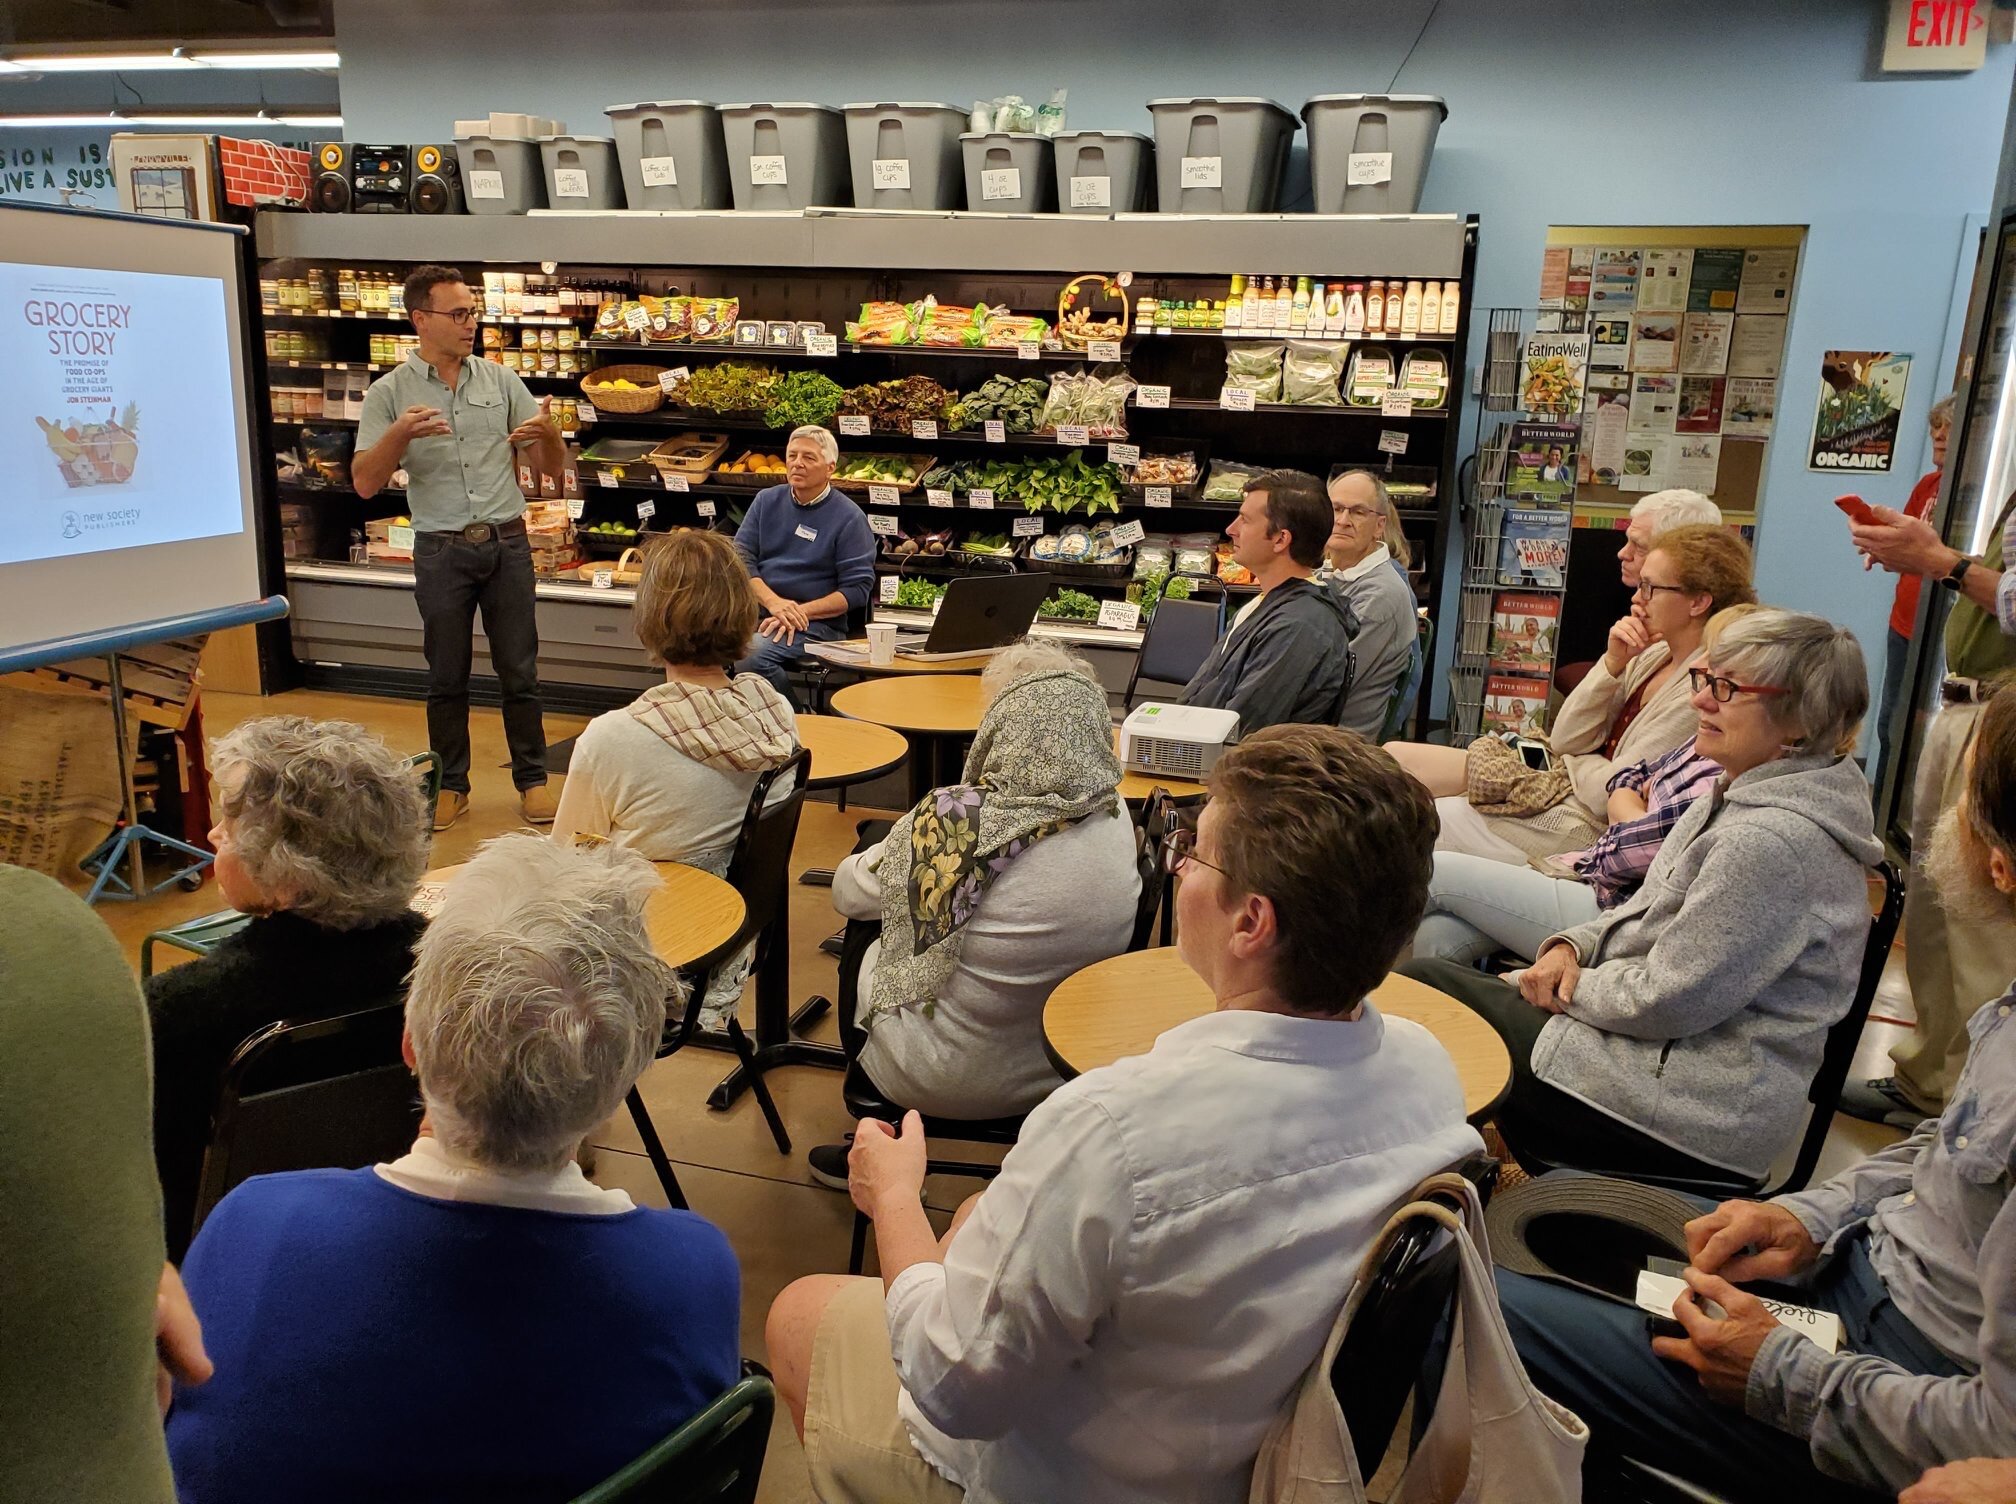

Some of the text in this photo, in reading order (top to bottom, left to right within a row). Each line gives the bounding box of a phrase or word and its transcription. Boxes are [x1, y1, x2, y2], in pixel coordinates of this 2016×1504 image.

[1907, 0, 1976, 46] EXIT
[80, 143, 101, 164] IS
[0, 170, 34, 194] IVE
[43, 169, 55, 188] A
[988, 174, 994, 184] 4
[989, 185, 1008, 194] cups
[1076, 182, 1096, 191] 2 oz
[1079, 193, 1097, 201] cups
[25, 300, 131, 329] GROCERY
[48, 330, 116, 356] STORY
[1528, 341, 1587, 358] EatingWell
[74, 359, 100, 367] PROMISE
[84, 368, 106, 376] CO-OPS
[1815, 452, 1889, 469] ORGANIC
[83, 509, 140, 522] new society
[84, 520, 136, 530] PUBLISHERS
[1503, 601, 1529, 609] BETTER
[1104, 609, 1136, 620] ASPARAGUS
[1491, 682, 1515, 690] BETTER
